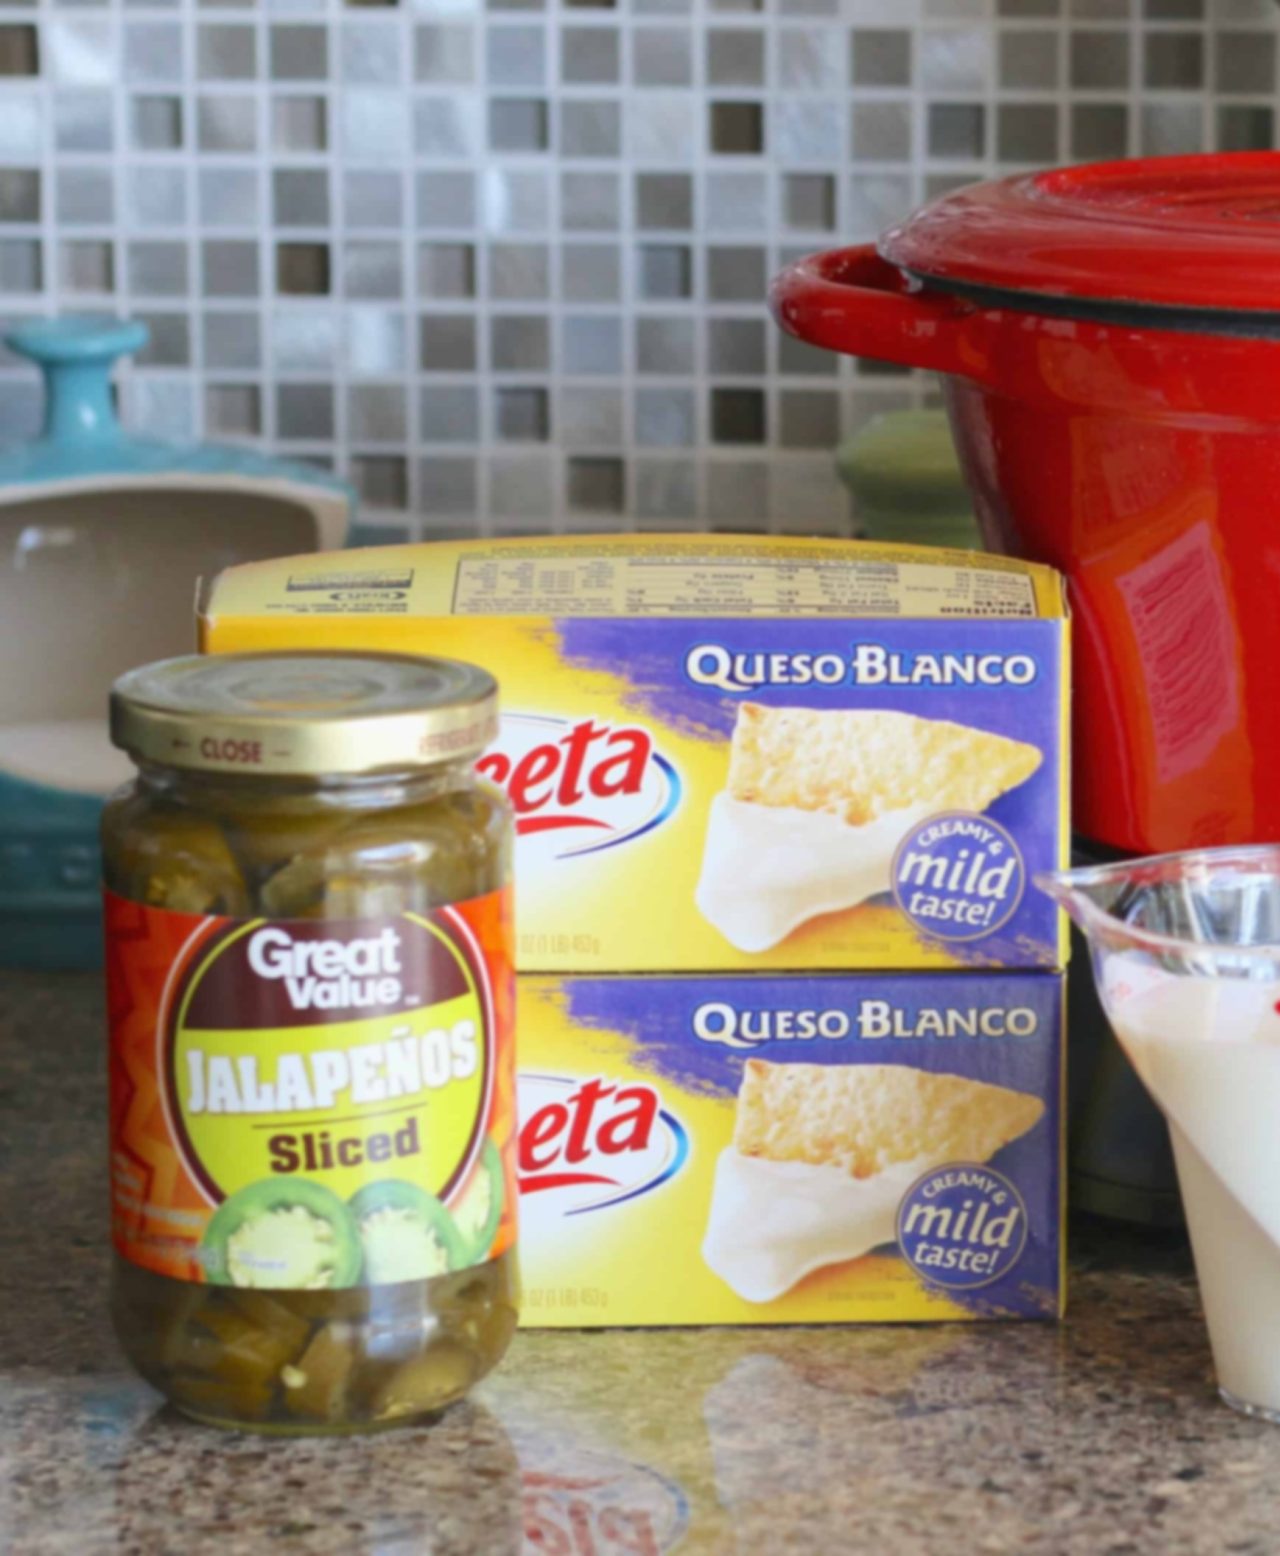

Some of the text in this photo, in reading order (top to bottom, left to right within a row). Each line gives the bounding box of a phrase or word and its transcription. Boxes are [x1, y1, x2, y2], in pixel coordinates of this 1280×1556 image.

[686, 644, 1037, 691] QUESO BLANCO
[200, 736, 263, 764] CLOSE
[917, 820, 992, 848] CREAMY
[897, 850, 1016, 900] mild
[908, 890, 997, 927] taste!
[247, 926, 401, 979] Great
[283, 973, 402, 1010] Value
[692, 1000, 1038, 1048] QUESO BLANCO
[185, 1018, 477, 1115] JALAPEÑOS
[267, 1116, 421, 1174] Sliced
[518, 1079, 659, 1173] eta
[922, 1172, 995, 1199] CREAMY
[903, 1202, 1019, 1249] mild
[913, 1241, 999, 1275] taste!
